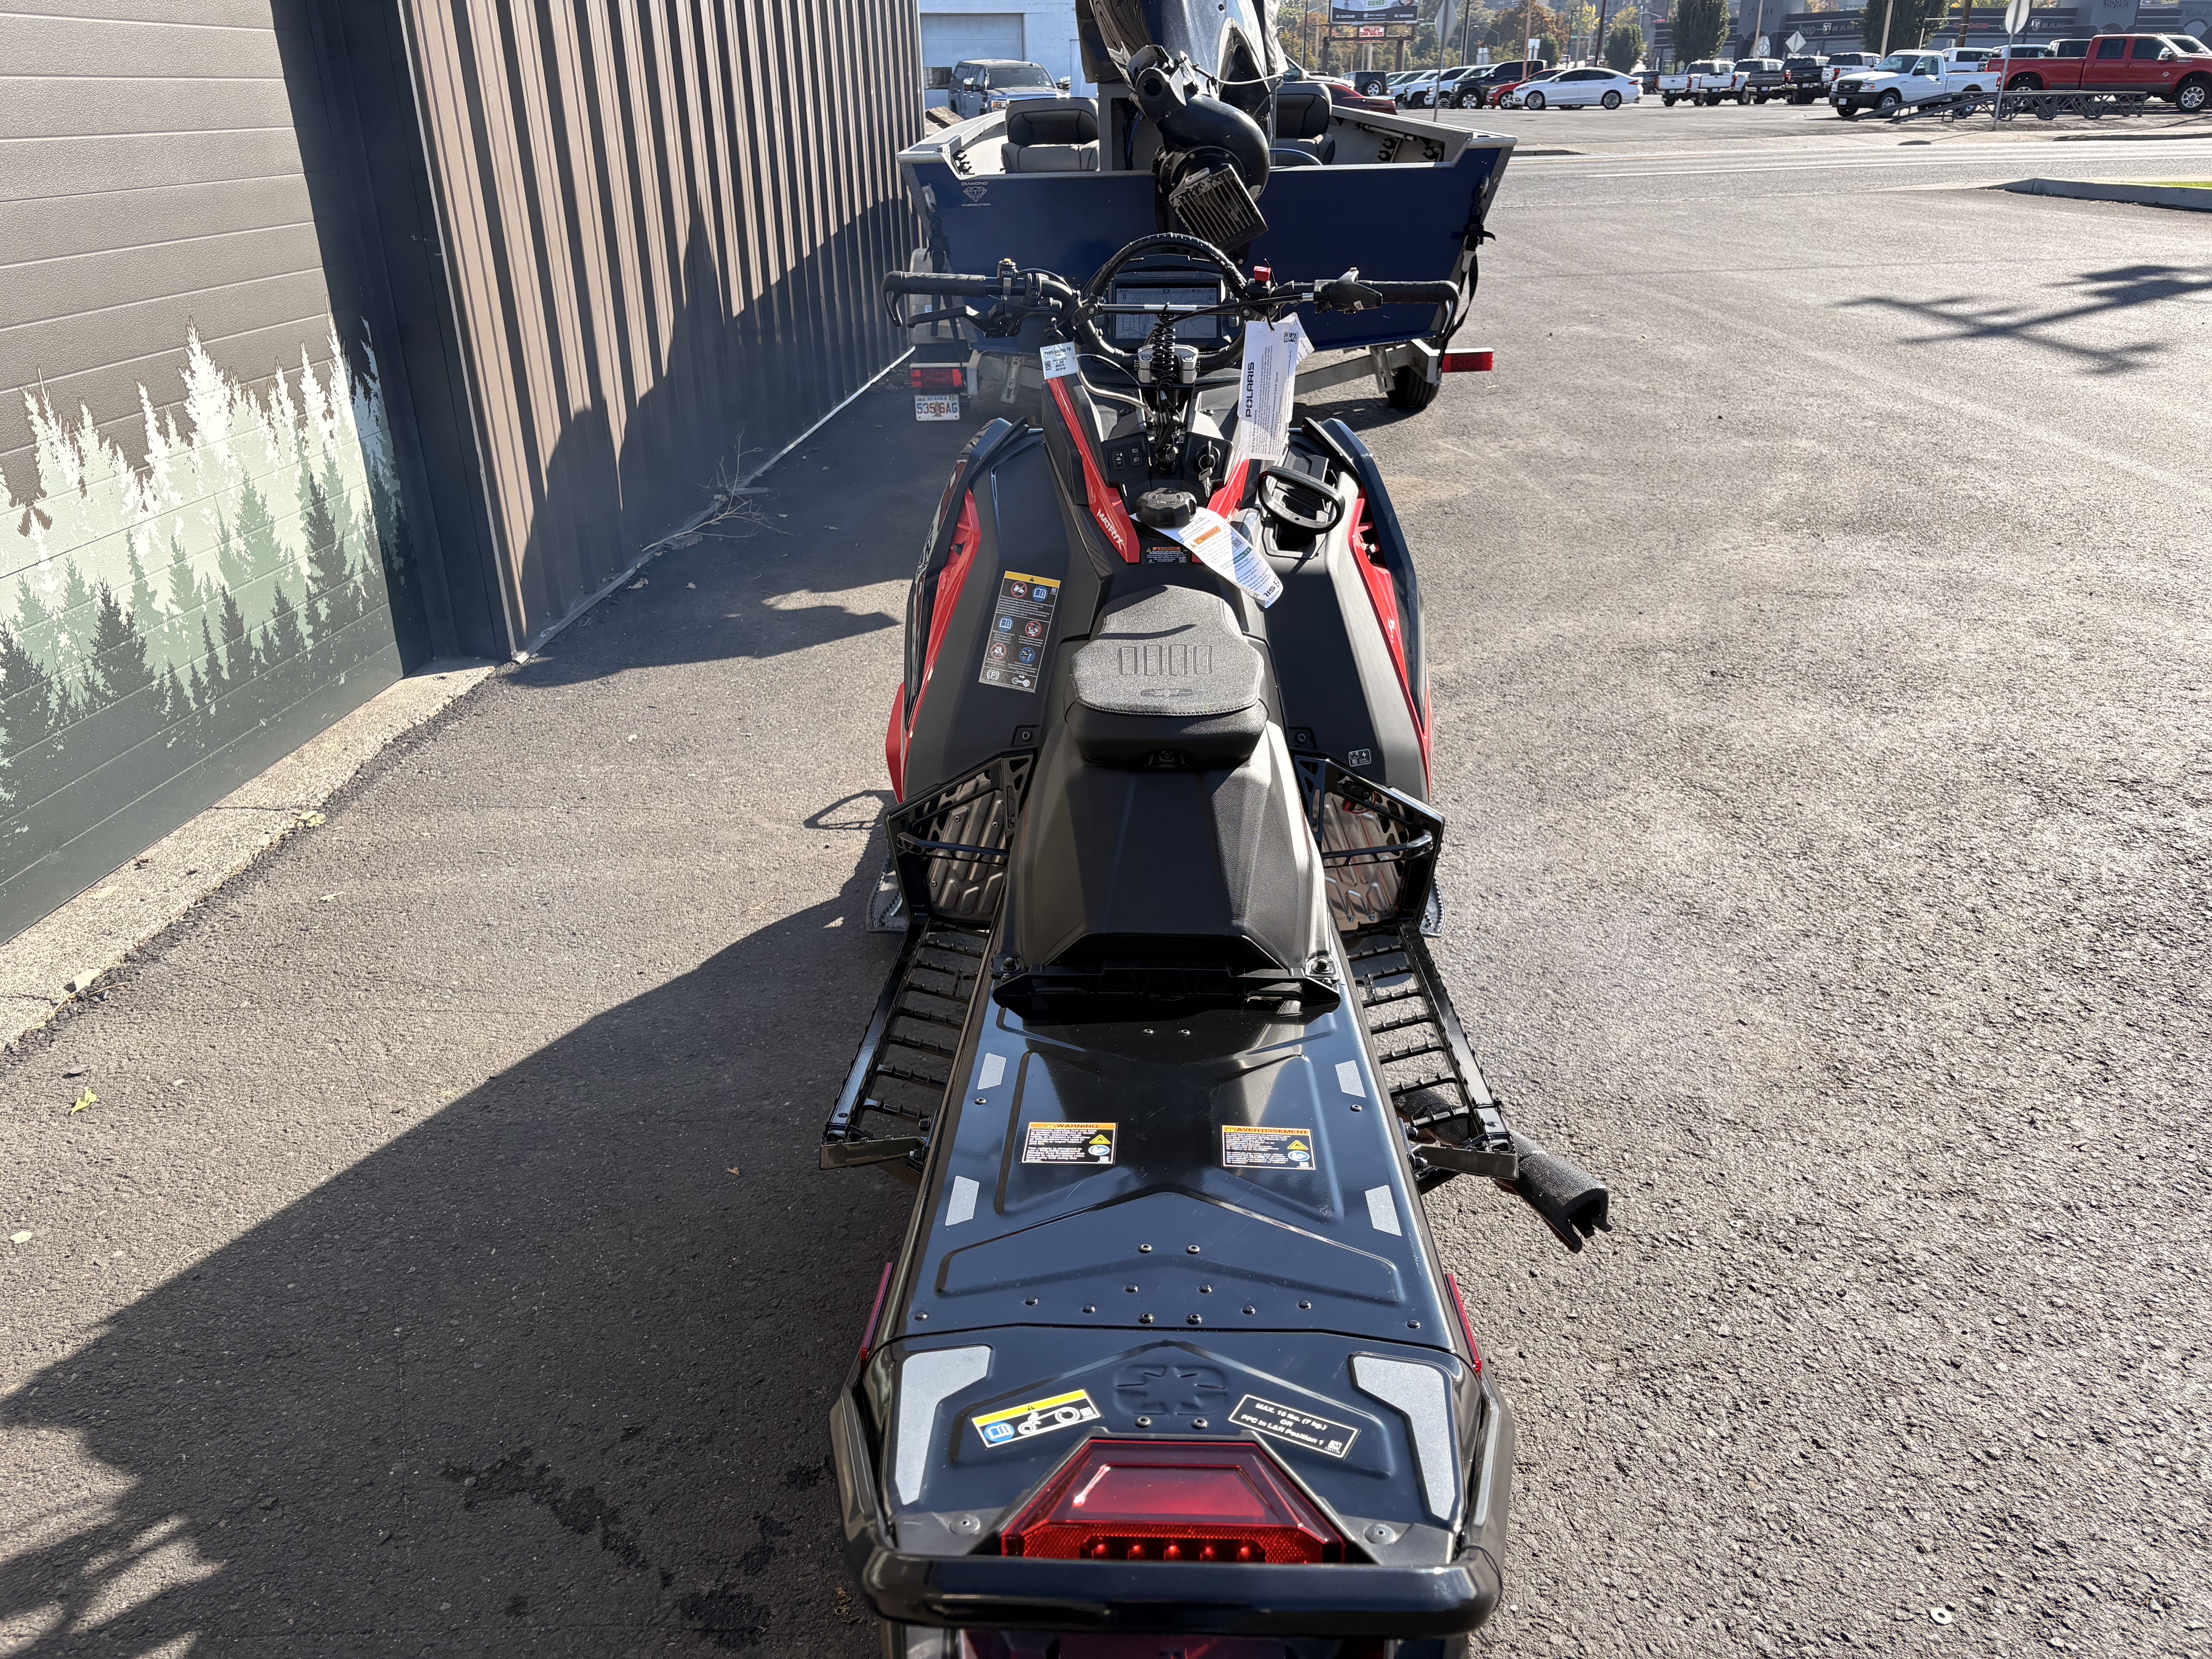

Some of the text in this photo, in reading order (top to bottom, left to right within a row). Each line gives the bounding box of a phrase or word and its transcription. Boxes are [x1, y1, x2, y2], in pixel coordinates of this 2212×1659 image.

[1799, 25, 1816, 35] Jeep
[1246, 362, 1254, 417] POLARIS
[1097, 508, 1123, 550] MATRYX
[1200, 528, 1220, 542] WARNING
[1255, 1403, 1274, 1413] MAX.
[1241, 1414, 1258, 1424] PFC
[1285, 1429, 1317, 1444] Position
